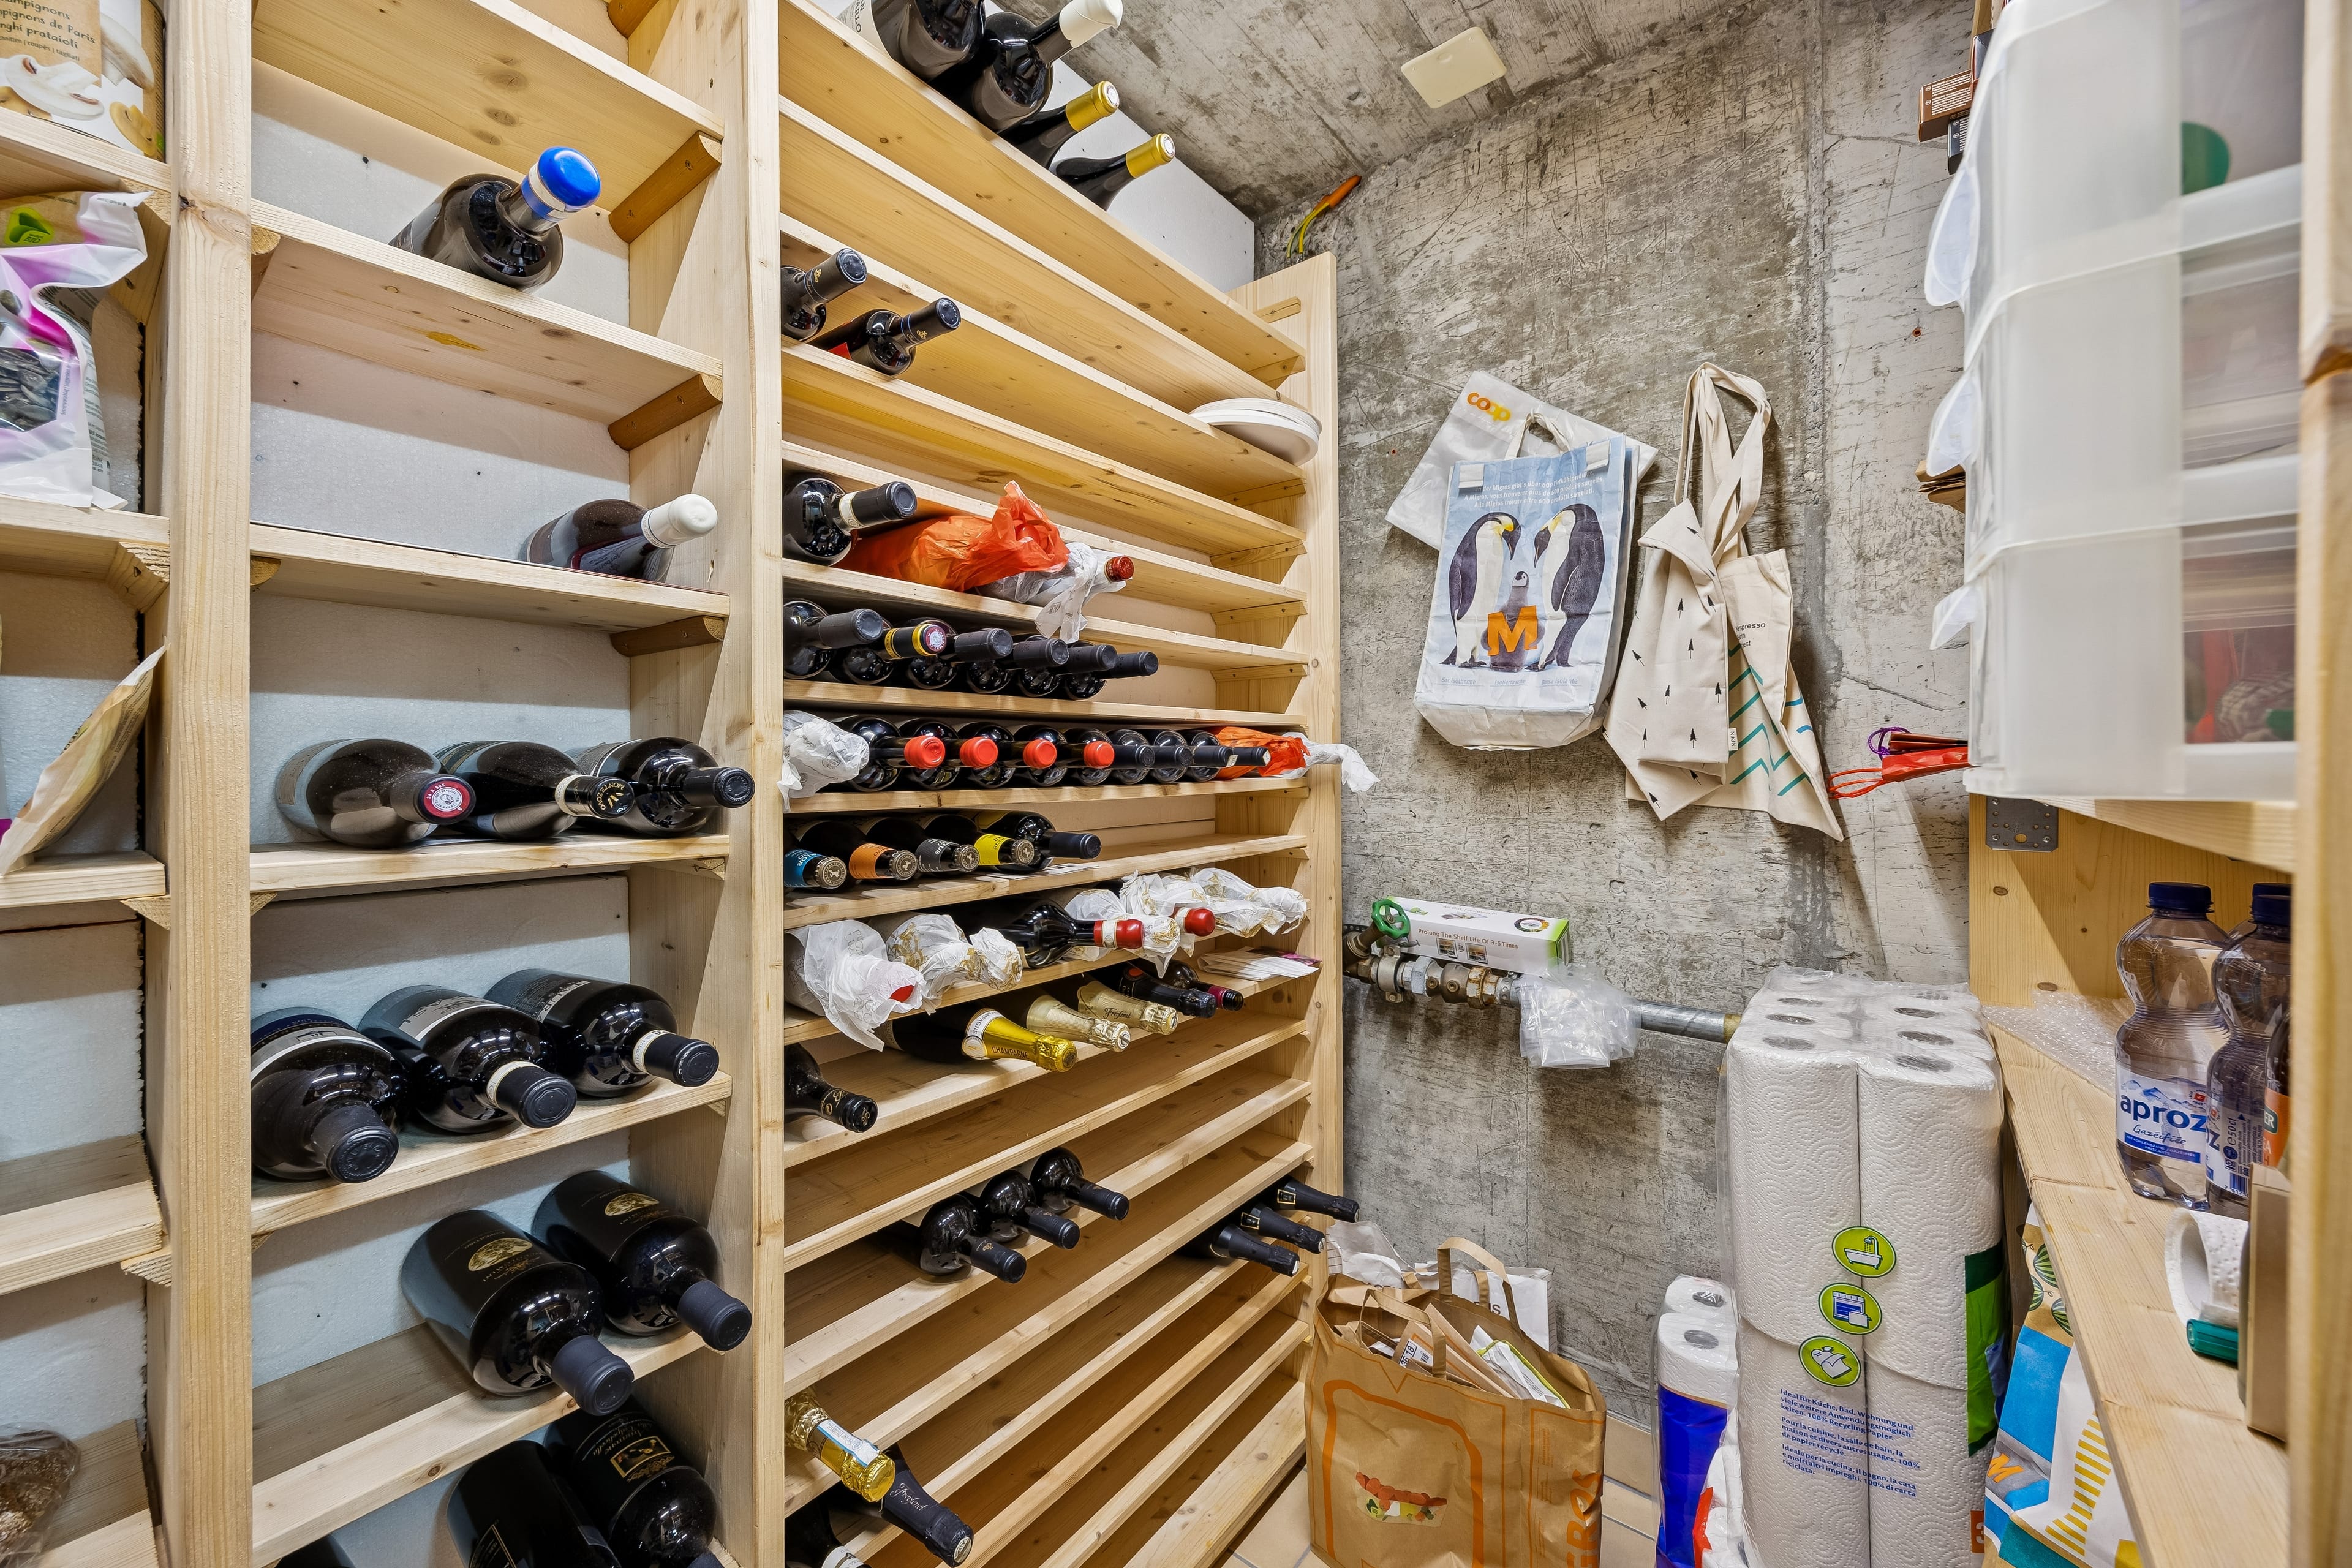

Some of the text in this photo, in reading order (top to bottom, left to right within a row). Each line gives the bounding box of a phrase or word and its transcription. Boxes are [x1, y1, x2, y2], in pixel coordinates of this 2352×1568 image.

[0, 9, 96, 43] pignons de Paris
[26, 28, 78, 49] prataioli
[27, 40, 50, 51] coupés
[1467, 392, 1511, 421] coop
[1511, 481, 1527, 491] gibt's
[1485, 499, 1504, 508] Migros
[1487, 605, 1539, 657] M
[597, 782, 625, 810] MONTE ZOVO
[1419, 929, 1439, 938] Prolong
[972, 1011, 1000, 1035] HAMPAGNE
[1103, 1007, 1132, 1019] Freixenet
[991, 1046, 1029, 1060] CHAMPAGNE
[2120, 1095, 2208, 1133] aproz
[2133, 1124, 2187, 1145] Gazéifiée
[1406, 1346, 1414, 1356] 18
[1781, 1389, 1798, 1400] Ideal
[1812, 1399, 1838, 1411] Küche,
[1839, 1406, 1856, 1415] Bad,
[1858, 1411, 1896, 1427] Wohnung
[1781, 1397, 1915, 1438] viele weitere Anwendungsmöglich-
[1781, 1403, 1894, 1441] keiten. 100% Recycling Papier.
[1782, 1417, 1800, 1427] Pour
[1808, 1427, 1836, 1439] cuisine,
[1875, 1444, 1895, 1455] bain,
[1782, 1425, 1809, 1438] maison
[1818, 1436, 1841, 1448] divers
[1842, 1444, 1868, 1454] autres
[1868, 1451, 1896, 1463] usages.
[1899, 1459, 1920, 1469] 100%
[1792, 1436, 1817, 1447] papier
[1817, 1444, 1846, 1457] recyclé.
[1782, 1459, 1815, 1474] riciclata.
[1782, 1444, 1805, 1457] Ideale
[1826, 1460, 1855, 1473] cucina,
[1862, 1470, 1888, 1482] bagno,
[1898, 1480, 1916, 1490] casa
[1787, 1454, 1807, 1466] molti
[1808, 1461, 1825, 1470] altri
[1825, 1465, 1862, 1482] impieghi.
[1864, 1479, 1885, 1489] 100%
[1894, 1487, 1917, 1497] carta
[890, 1483, 929, 1513] Freixenet
